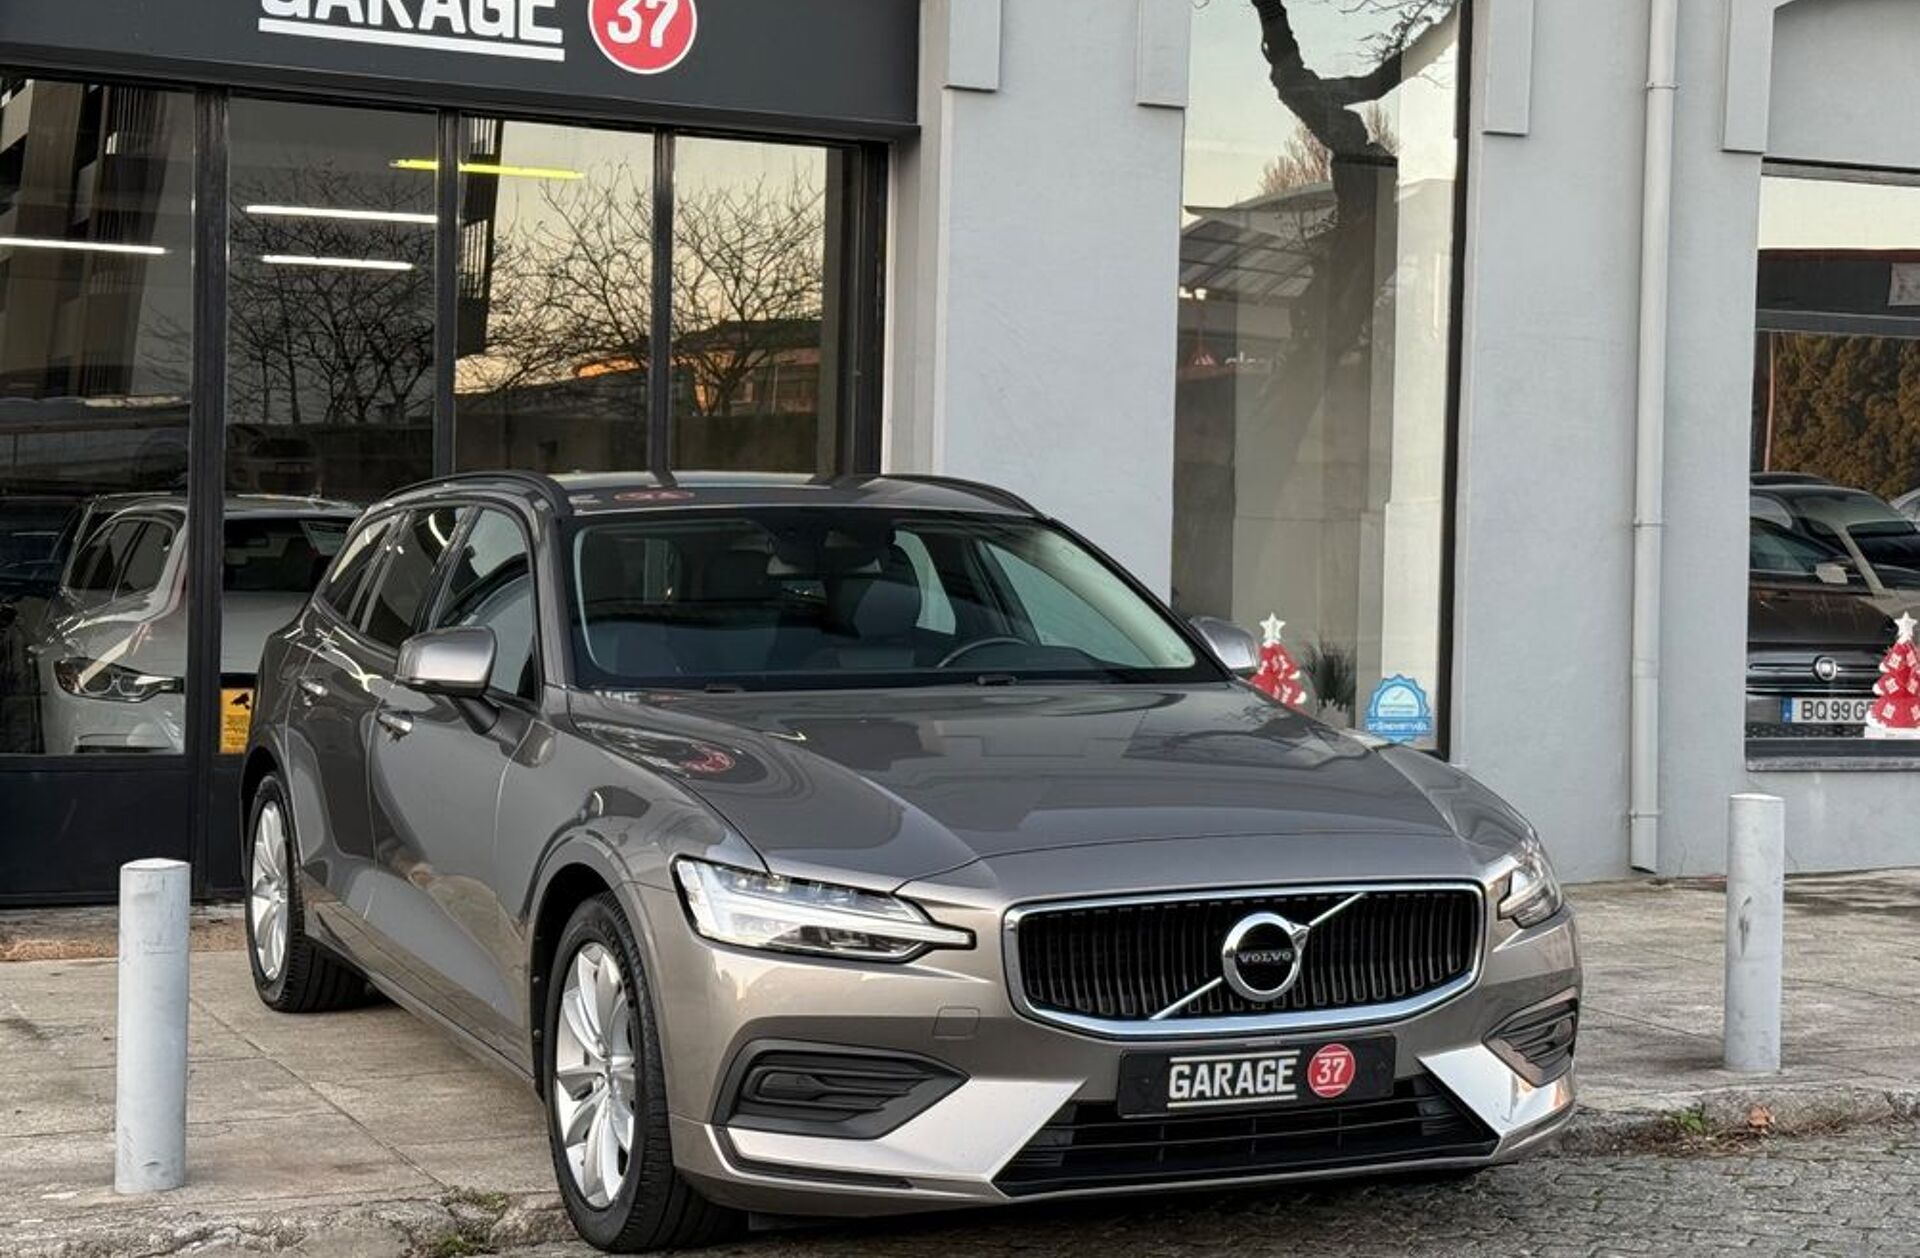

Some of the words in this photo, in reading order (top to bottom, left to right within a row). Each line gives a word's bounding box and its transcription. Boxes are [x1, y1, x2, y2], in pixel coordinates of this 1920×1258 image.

[606, 0, 676, 48] 37
[1239, 951, 1292, 963] VOLVO
[1168, 1058, 1297, 1099] GARAGE
[1316, 1057, 1346, 1085] 37
